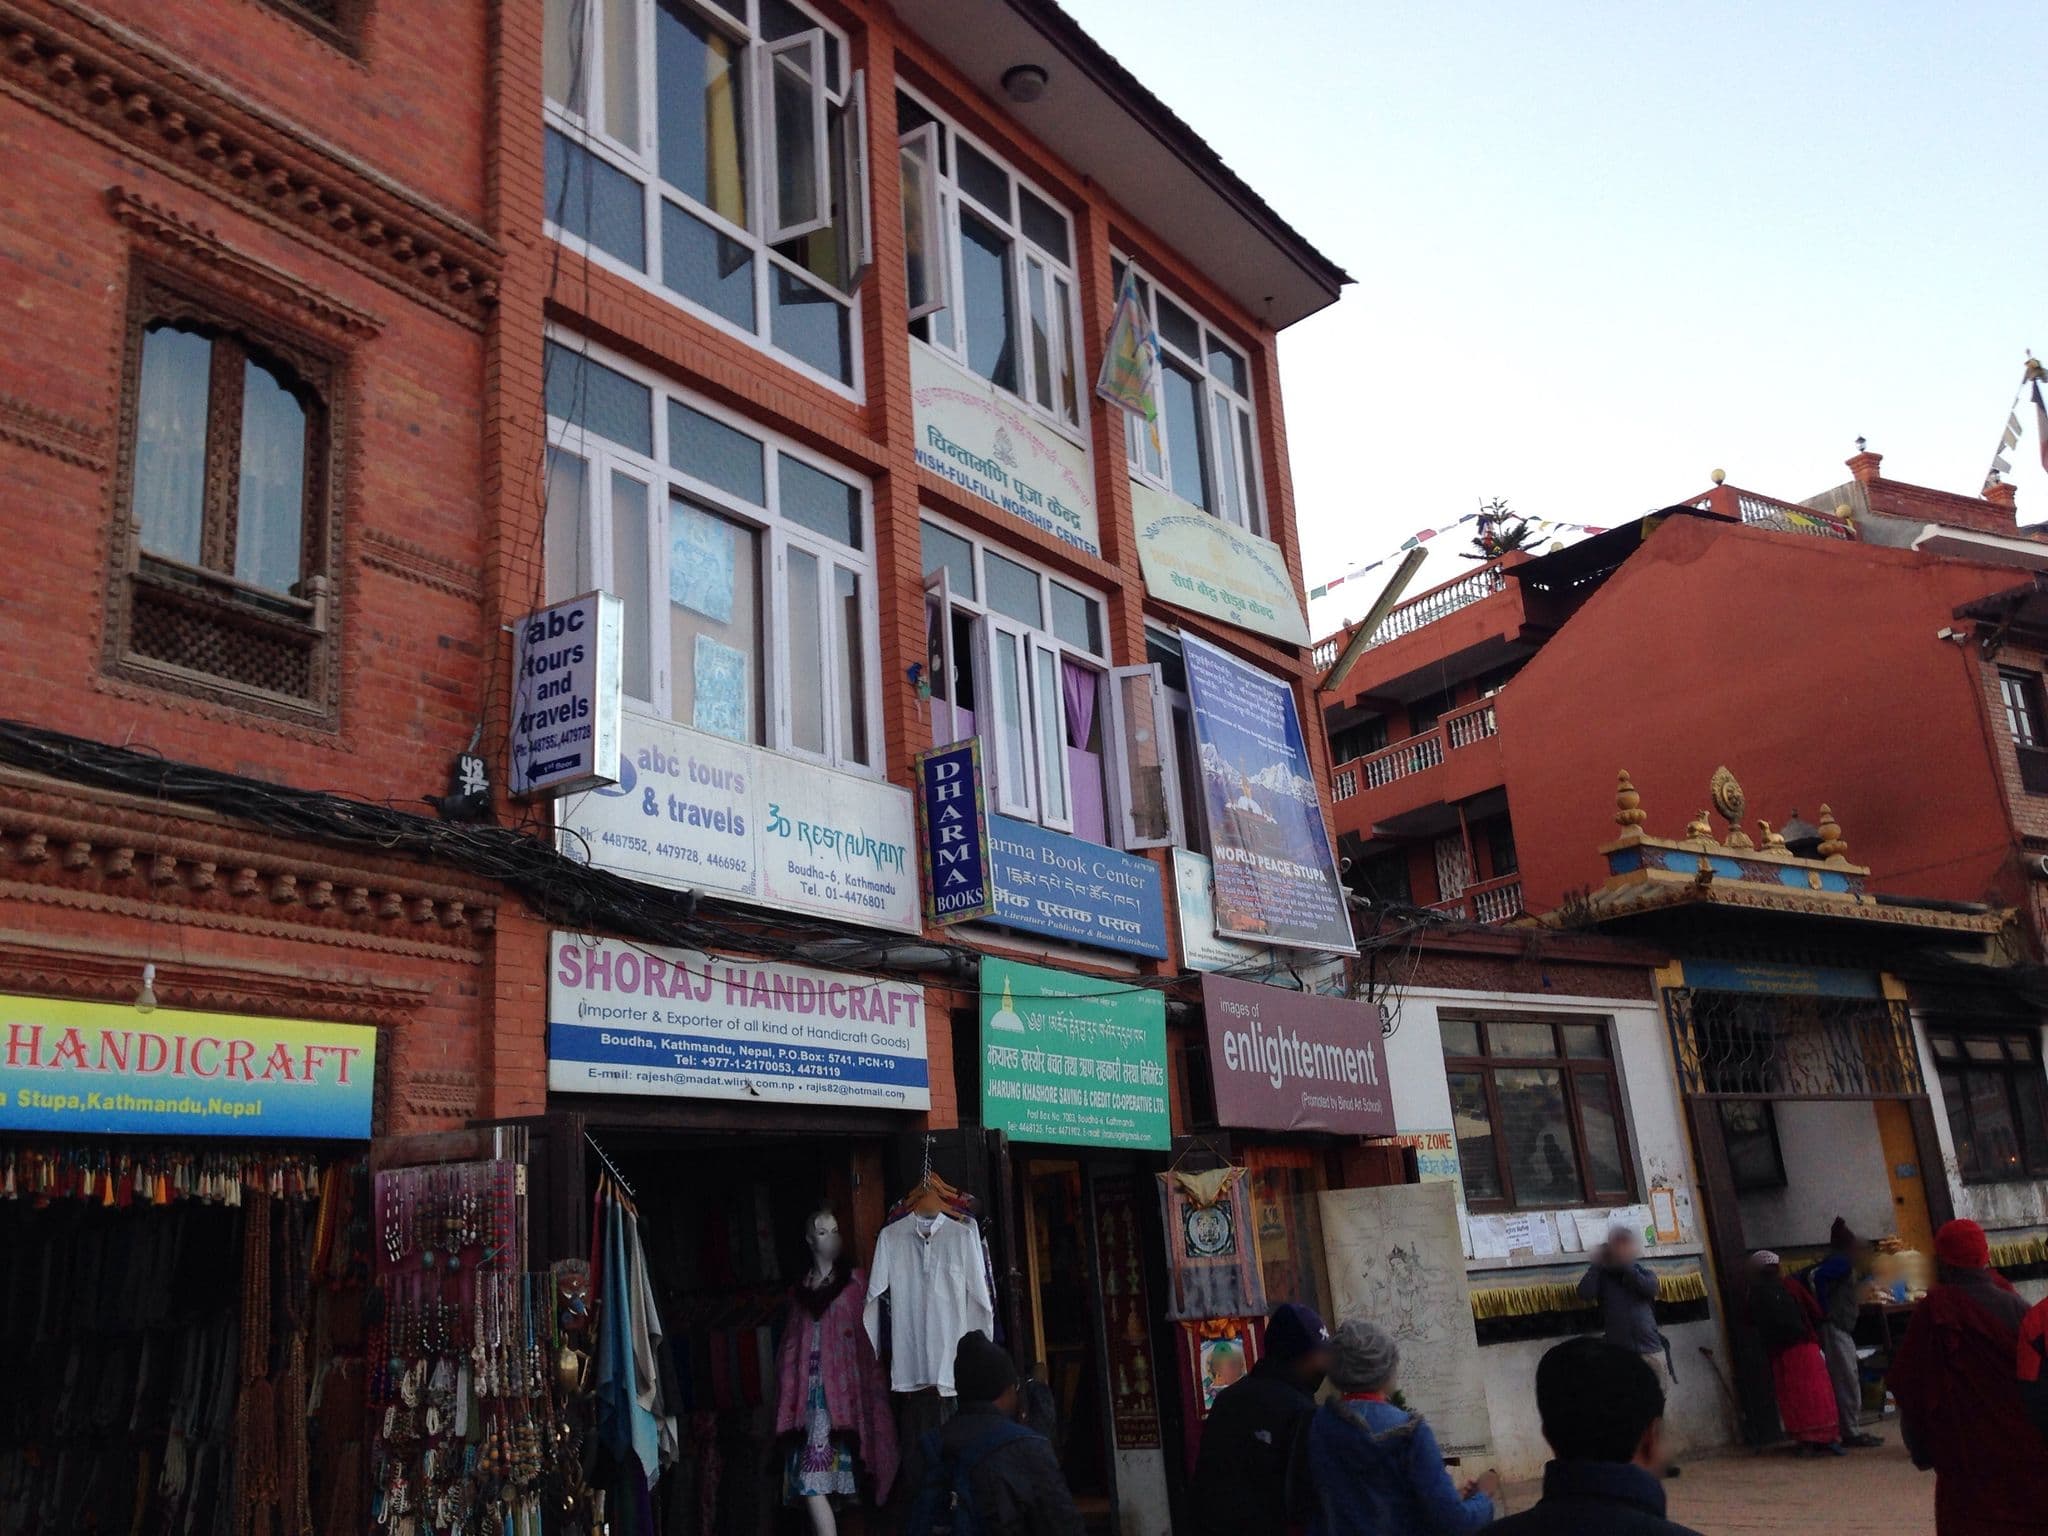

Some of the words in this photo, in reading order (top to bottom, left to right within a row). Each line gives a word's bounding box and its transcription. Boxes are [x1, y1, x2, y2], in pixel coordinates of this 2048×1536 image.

[1000, 495, 1053, 531] WORSHIP
[1056, 526, 1098, 557] CENTER
[528, 609, 584, 644] abc
[527, 644, 584, 677] tours
[537, 671, 572, 700] and
[520, 695, 588, 734] travels
[638, 745, 680, 778] abc
[688, 757, 744, 794] tours
[642, 786, 659, 817] &
[668, 793, 745, 836] travels
[935, 762, 971, 888] DHARMA
[602, 831, 651, 855] 4487552,
[656, 843, 701, 865] 4479728,
[707, 853, 746, 873] 4466962
[766, 803, 791, 838] 3D
[798, 821, 906, 875] RESTAURANT
[990, 837, 1035, 862] arma
[1042, 847, 1087, 875] Book
[1092, 863, 1145, 890] Center
[1215, 845, 1256, 866] WORLD
[1257, 854, 1292, 874] PEACE
[1294, 864, 1327, 882] STUPA
[801, 881, 819, 898] Tel.
[826, 886, 885, 910] 01-4476801
[845, 874, 895, 895] Kathmandu
[937, 888, 984, 911] BOOKS
[1004, 910, 1046, 928] Literature
[1048, 919, 1085, 936] Publisher
[1096, 931, 1116, 942] Book
[1036, 899, 1092, 923] पुस्तक
[1098, 914, 1142, 934] पसल
[558, 944, 712, 1002] SHORAJ
[726, 967, 919, 1028] HANDICRAFT
[1220, 999, 1249, 1018] images
[1252, 1003, 1259, 1017] of
[601, 1033, 656, 1049] Boudha,
[660, 1038, 735, 1056] Kathmandu,
[739, 1046, 775, 1059] Nepal,
[652, 1011, 661, 1022] &
[668, 1011, 723, 1028] Exporter
[727, 1018, 740, 1031] of
[744, 1021, 758, 1031] all
[762, 1021, 787, 1034] kind
[792, 1024, 803, 1037] of
[807, 1027, 867, 1043] Handicraft
[871, 1033, 910, 1050] Goods)
[6, 1023, 361, 1085] HANDICRAFT
[675, 1054, 696, 1065] Tel:
[797, 1065, 840, 1076] 4478119
[1223, 1021, 1378, 1089] enlightenment
[588, 1068, 632, 1080] E-mail:
[1022, 1083, 1058, 1104] KHASHORE
[1059, 1088, 1082, 1106] SAVING
[1090, 1091, 1110, 1108] CREDIT
[1427, 1134, 1452, 1150] ZONE
